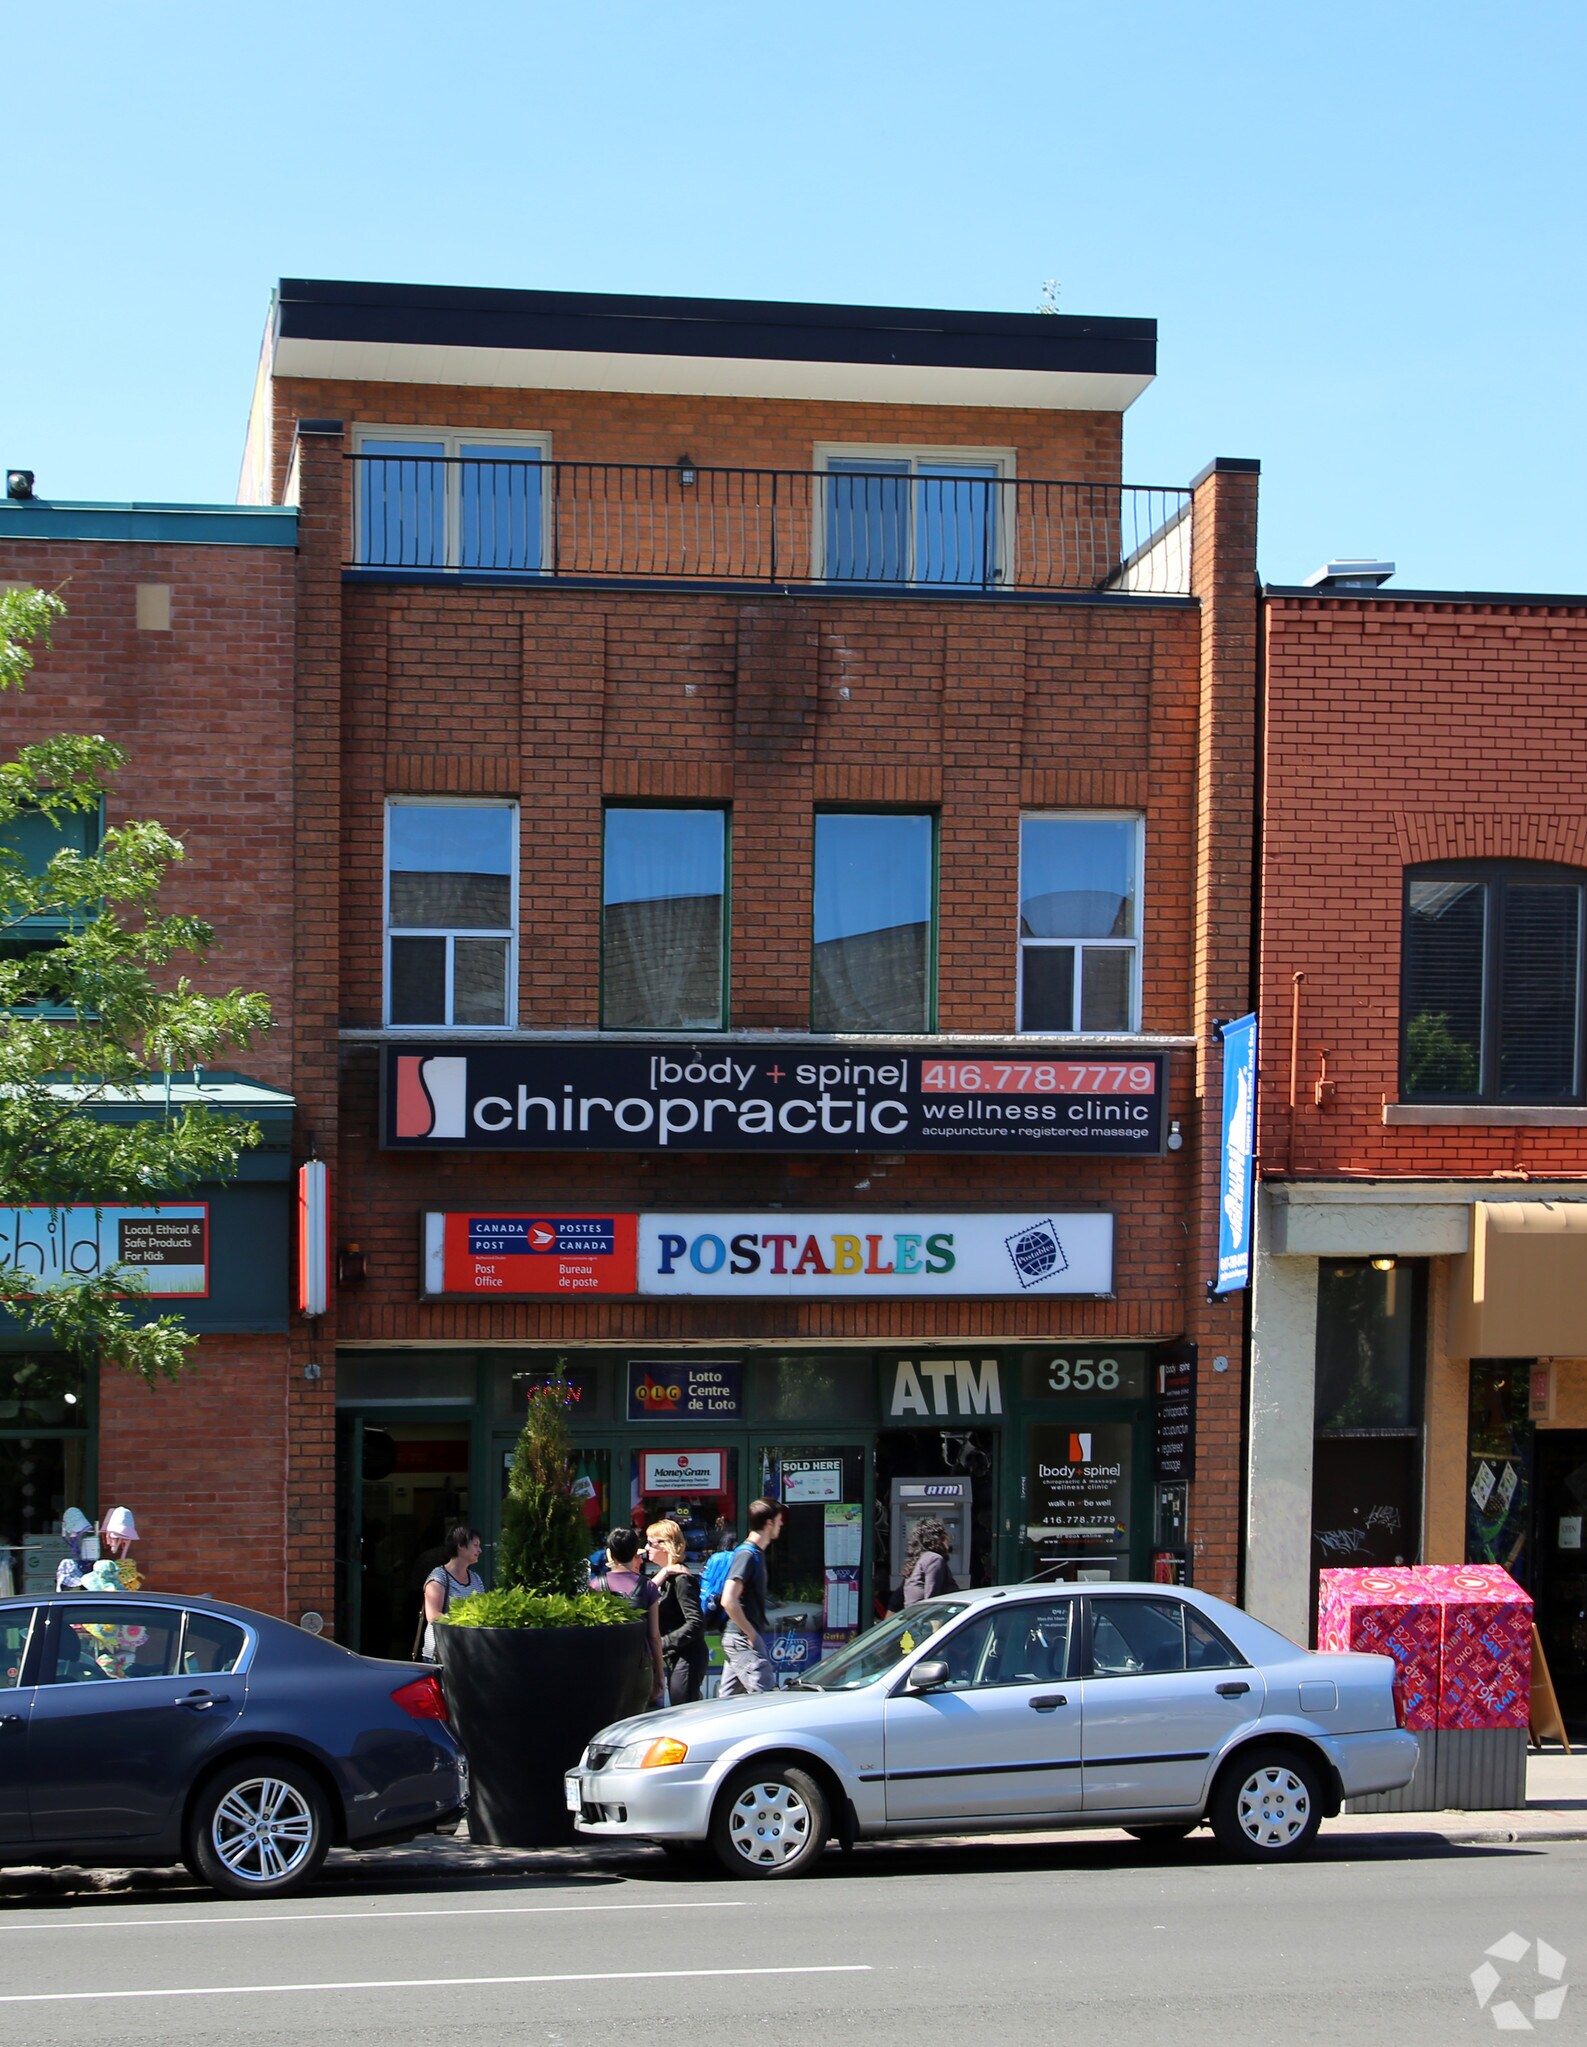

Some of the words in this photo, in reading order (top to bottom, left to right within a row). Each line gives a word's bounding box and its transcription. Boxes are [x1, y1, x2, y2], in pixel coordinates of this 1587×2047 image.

[650, 1056, 756, 1090] [body
[796, 1058, 907, 1092] spine]
[923, 1065, 1152, 1091] 416.778.7779
[473, 1083, 908, 1145] chiropractic
[922, 1099, 1057, 1120] wellness
[1068, 1099, 1149, 1121] clinic
[922, 1126, 1008, 1138] acupuncture
[1018, 1126, 1089, 1138] registered
[1091, 1127, 1149, 1139] massage
[124, 1225, 153, 1236] Local,
[156, 1224, 190, 1235] Ethical
[191, 1225, 200, 1235] &
[476, 1224, 524, 1233] CANADA
[560, 1224, 602, 1233] POSTES
[124, 1238, 147, 1248] Safe
[149, 1238, 192, 1248] Products
[476, 1241, 504, 1250] POST
[559, 1241, 607, 1250] CANADA
[124, 1252, 142, 1261] For
[144, 1251, 164, 1261] Kids
[657, 1233, 956, 1275] POSTABLES
[1017, 1244, 1055, 1265] Postables
[475, 1264, 496, 1274] Post
[559, 1264, 593, 1274] Bureau
[475, 1276, 503, 1287] Office
[559, 1277, 571, 1287] de
[572, 1277, 599, 1289] poste
[689, 1371, 722, 1382] Lotto
[1049, 1359, 1120, 1391] 358
[637, 1387, 678, 1399] OLG
[688, 1385, 730, 1396] Centre
[890, 1360, 1003, 1415] ATM
[688, 1398, 704, 1410] de
[708, 1398, 736, 1410] Loto
[654, 1467, 711, 1478] MoneyGram
[782, 1462, 810, 1472] SOLD
[812, 1461, 840, 1471] HERE
[1039, 1464, 1076, 1479] [body
[1083, 1463, 1121, 1478] spine]
[1042, 1516, 1116, 1524] 416.778.7779
[1362, 1616, 1382, 1638] G5N
[1456, 1614, 1476, 1636] G5N
[1393, 1625, 1418, 1652] B2Z
[1487, 1622, 1512, 1649] B2Z
[1473, 1676, 1499, 1710] T9K
[1494, 1689, 1517, 1712] K4A
